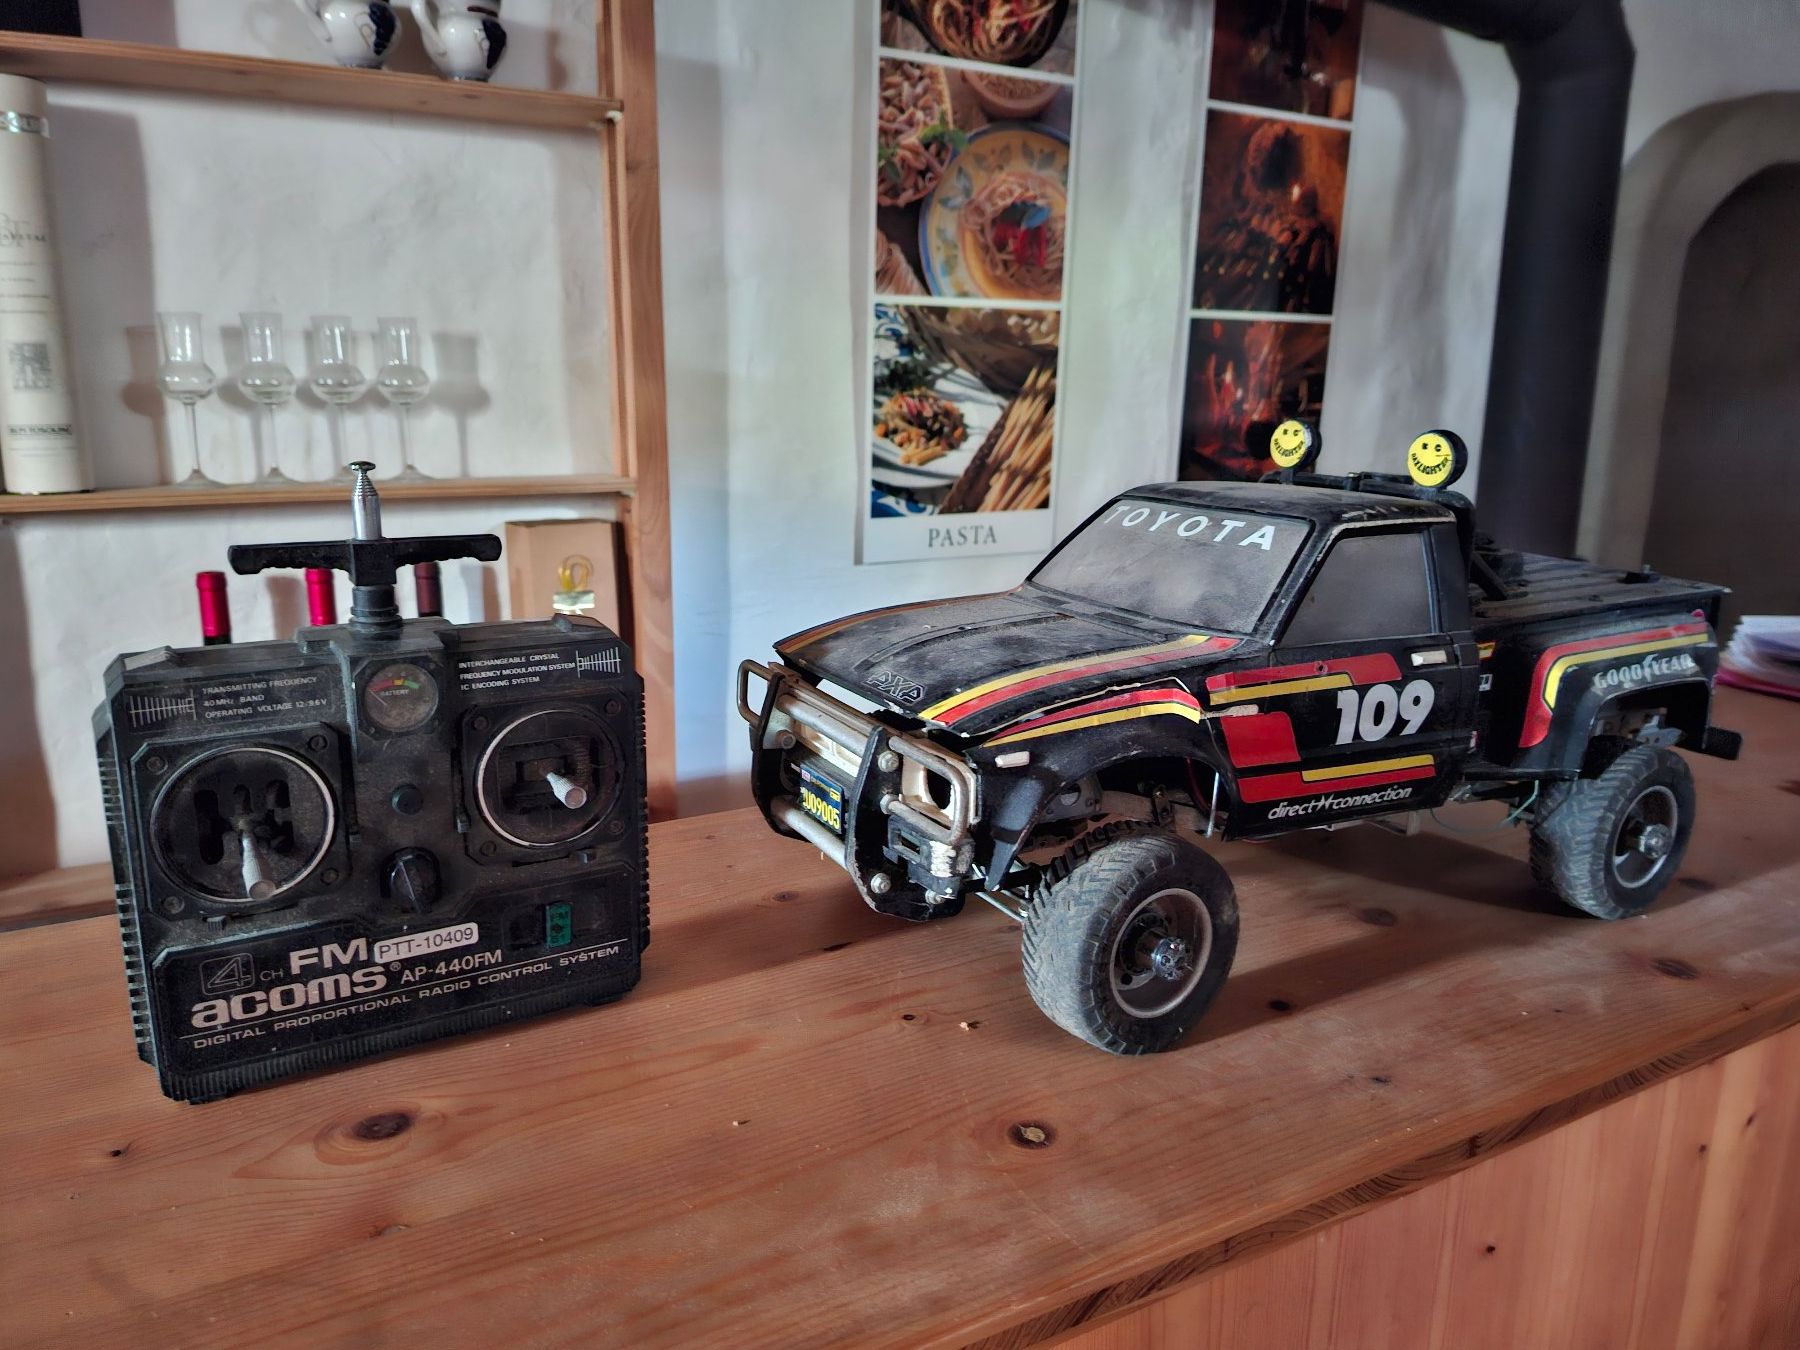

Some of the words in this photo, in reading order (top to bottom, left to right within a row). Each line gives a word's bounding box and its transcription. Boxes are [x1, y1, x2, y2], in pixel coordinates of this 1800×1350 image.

[927, 524, 997, 548] PASTA
[1103, 504, 1277, 551] TOYOTA
[458, 656, 527, 669] INTERCHANGEABLE
[529, 652, 560, 662] CRYSTAL
[459, 669, 501, 680] FREQUENCY
[501, 664, 548, 676] MODULATION
[548, 662, 576, 671] SYSTEM
[201, 681, 268, 695] TRANSMITTING
[268, 676, 318, 688] FREQUENCY
[460, 683, 470, 691] IC
[471, 679, 510, 690] ENCODING
[511, 676, 541, 685] SYSTEM
[204, 706, 253, 719] OPERATING
[257, 702, 294, 713] VOLTAGE
[239, 695, 265, 703] BAND
[1335, 678, 1436, 746] 109
[378, 926, 474, 959] PTT-10409
[259, 968, 284, 982] CH
[289, 937, 369, 975] FM
[190, 965, 388, 1029] acoms
[400, 948, 503, 985] AP-440FM
[193, 1026, 266, 1049] DIGITAL
[273, 994, 412, 1032] PROPORTIONAL
[418, 979, 471, 999] RADIO
[477, 962, 553, 985] CONTROL
[559, 945, 620, 967] SYSTEM
